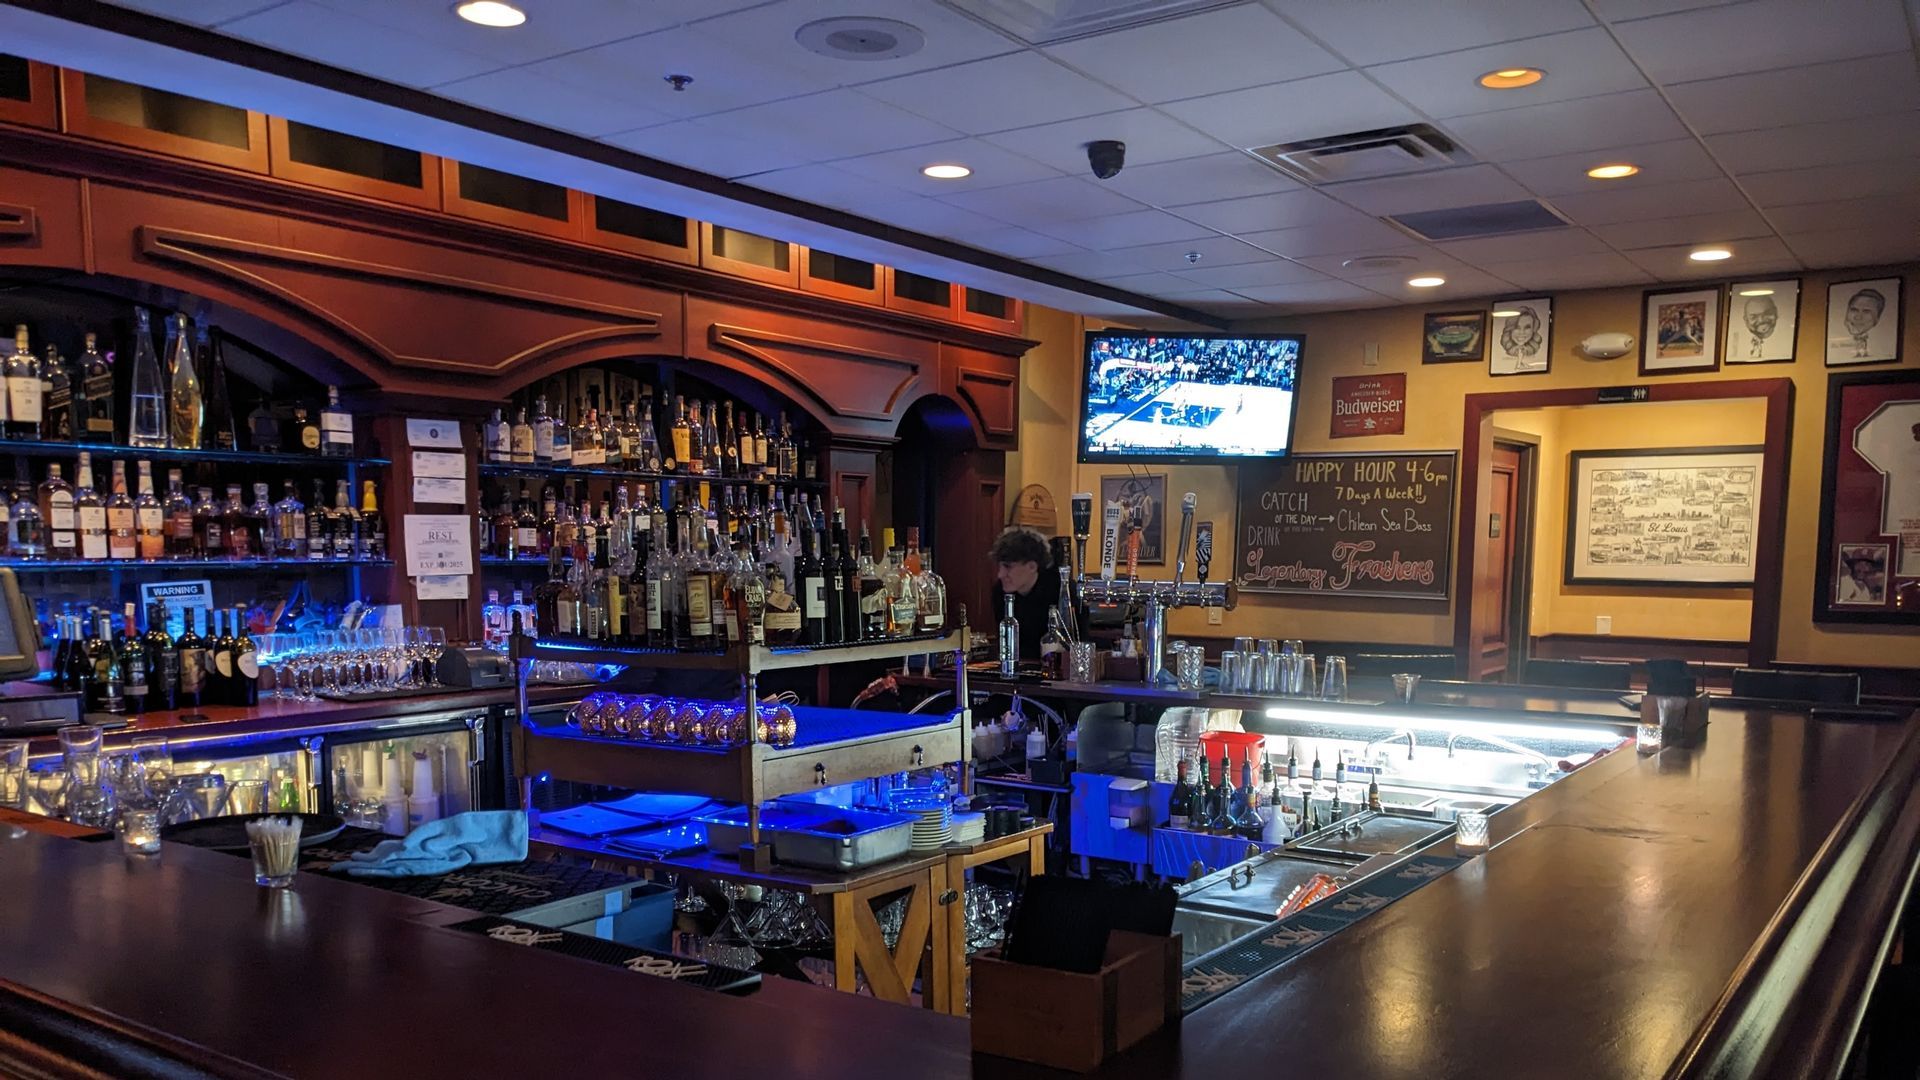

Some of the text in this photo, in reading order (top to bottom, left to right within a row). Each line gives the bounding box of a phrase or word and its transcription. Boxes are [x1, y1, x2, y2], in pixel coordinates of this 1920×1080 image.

[1336, 397, 1403, 416] Budweiser
[1296, 462, 1344, 483] HAPPY
[1354, 461, 1396, 483] HOUR
[1261, 491, 1308, 512] CATCH
[1335, 486, 1344, 500] 7
[1347, 487, 1371, 505] Days
[1374, 488, 1381, 499] A
[1274, 514, 1317, 526] OF THE DAY
[1337, 507, 1432, 532] Chilean Sea Bass
[1661, 522, 1688, 533] Louis
[1248, 525, 1280, 546] DRINK
[1104, 528, 1114, 569] BLONDE
[1244, 547, 1327, 591] Legendary
[153, 586, 198, 596] WARNING
